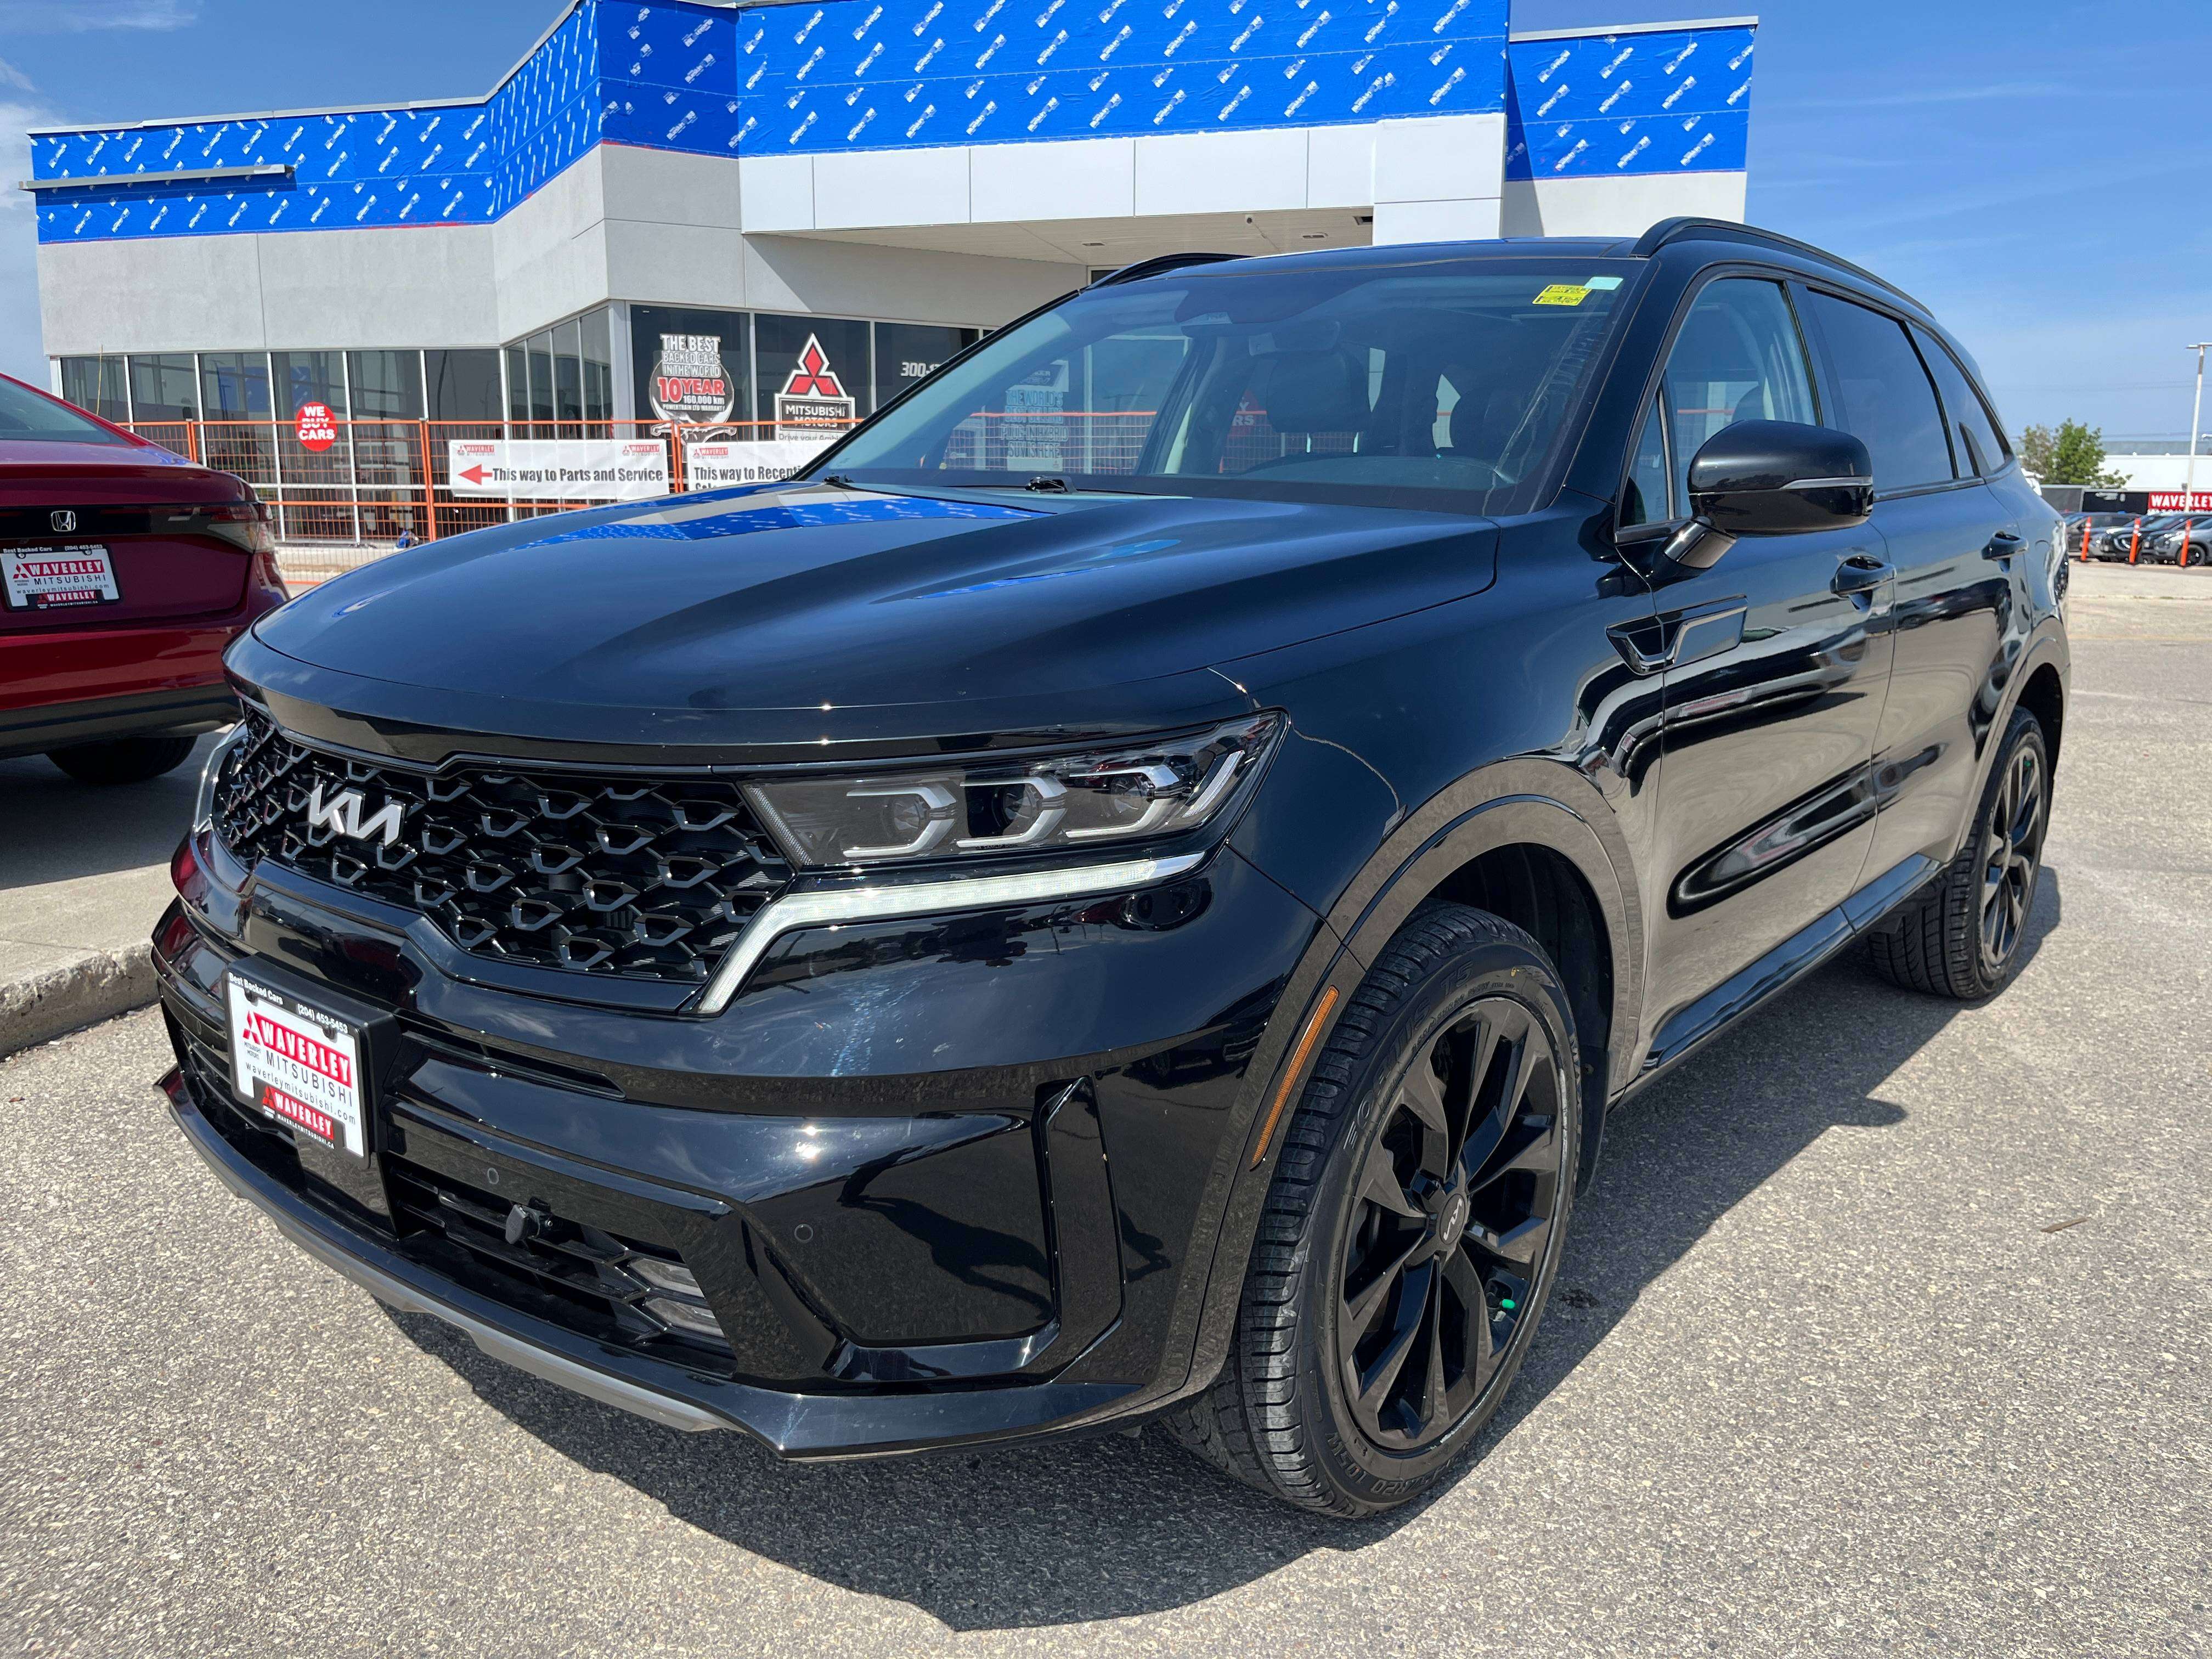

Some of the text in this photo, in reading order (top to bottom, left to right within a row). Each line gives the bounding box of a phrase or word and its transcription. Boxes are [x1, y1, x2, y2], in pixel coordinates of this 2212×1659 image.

[661, 335, 721, 352] THE BEST
[663, 352, 720, 364] BACKED CARS
[691, 365, 721, 377] WORLD
[658, 377, 725, 403] 10 YEAR
[683, 396, 725, 405] 160,000 km
[303, 405, 325, 417] WE
[786, 405, 846, 417] MITSUBISHI
[302, 417, 329, 428] BUY
[298, 428, 335, 441] CARS
[493, 468, 663, 482] This way to Parts and Service
[694, 467, 718, 480] This
[719, 469, 742, 481] way
[744, 467, 755, 480] to
[29, 561, 103, 575] WAVERLEY
[34, 574, 106, 585] MITSUBISHI
[16, 583, 110, 594] waverleymitsubishi.com
[46, 590, 95, 602] WAVERLEY
[229, 972, 348, 1034] Best Backed Cars (204) 453-5453
[260, 1018, 349, 1083] WAVERLEY
[266, 1049, 352, 1107] MITSUBISHI
[245, 1062, 356, 1125] waverleymitsubishi.com
[274, 1092, 332, 1136] WAVERLEY
